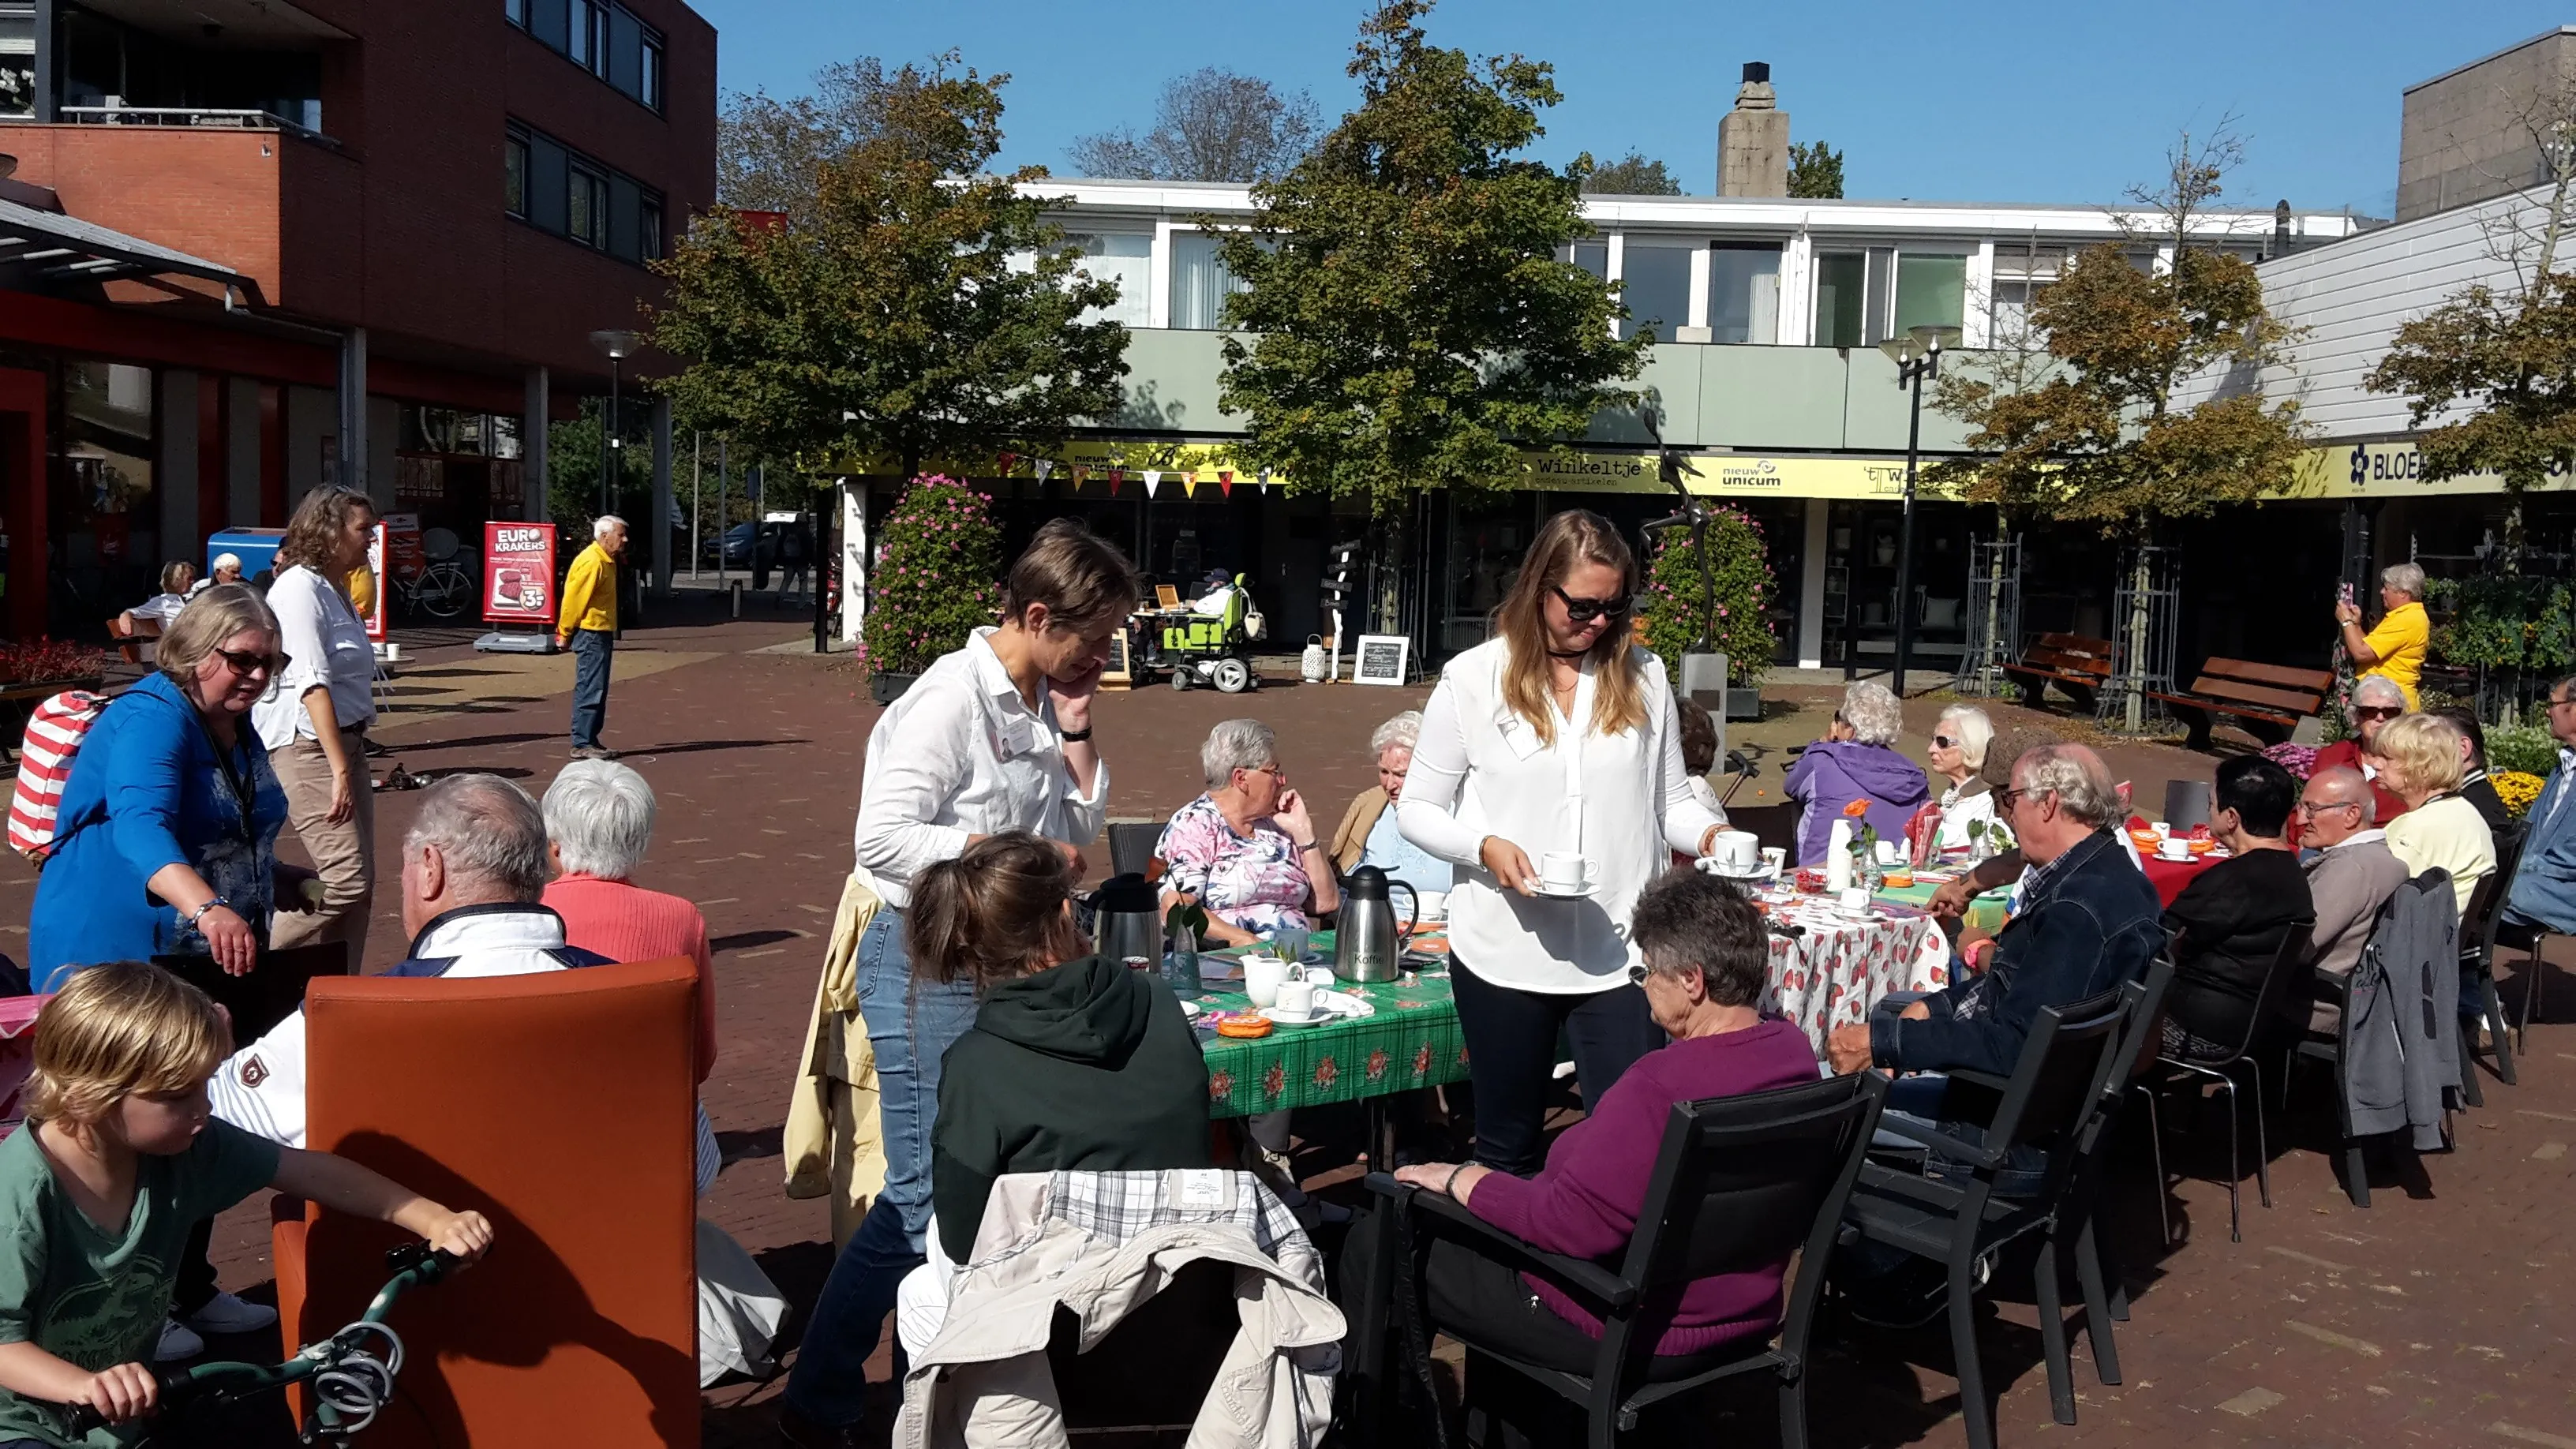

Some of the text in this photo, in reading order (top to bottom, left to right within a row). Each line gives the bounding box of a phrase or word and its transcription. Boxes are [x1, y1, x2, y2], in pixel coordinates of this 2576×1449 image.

[1537, 456, 1641, 478] Winkeltje
[1722, 477, 1780, 486] unicum
[495, 541, 545, 552] KRAKERS
[1354, 953, 1384, 964] Koffie
